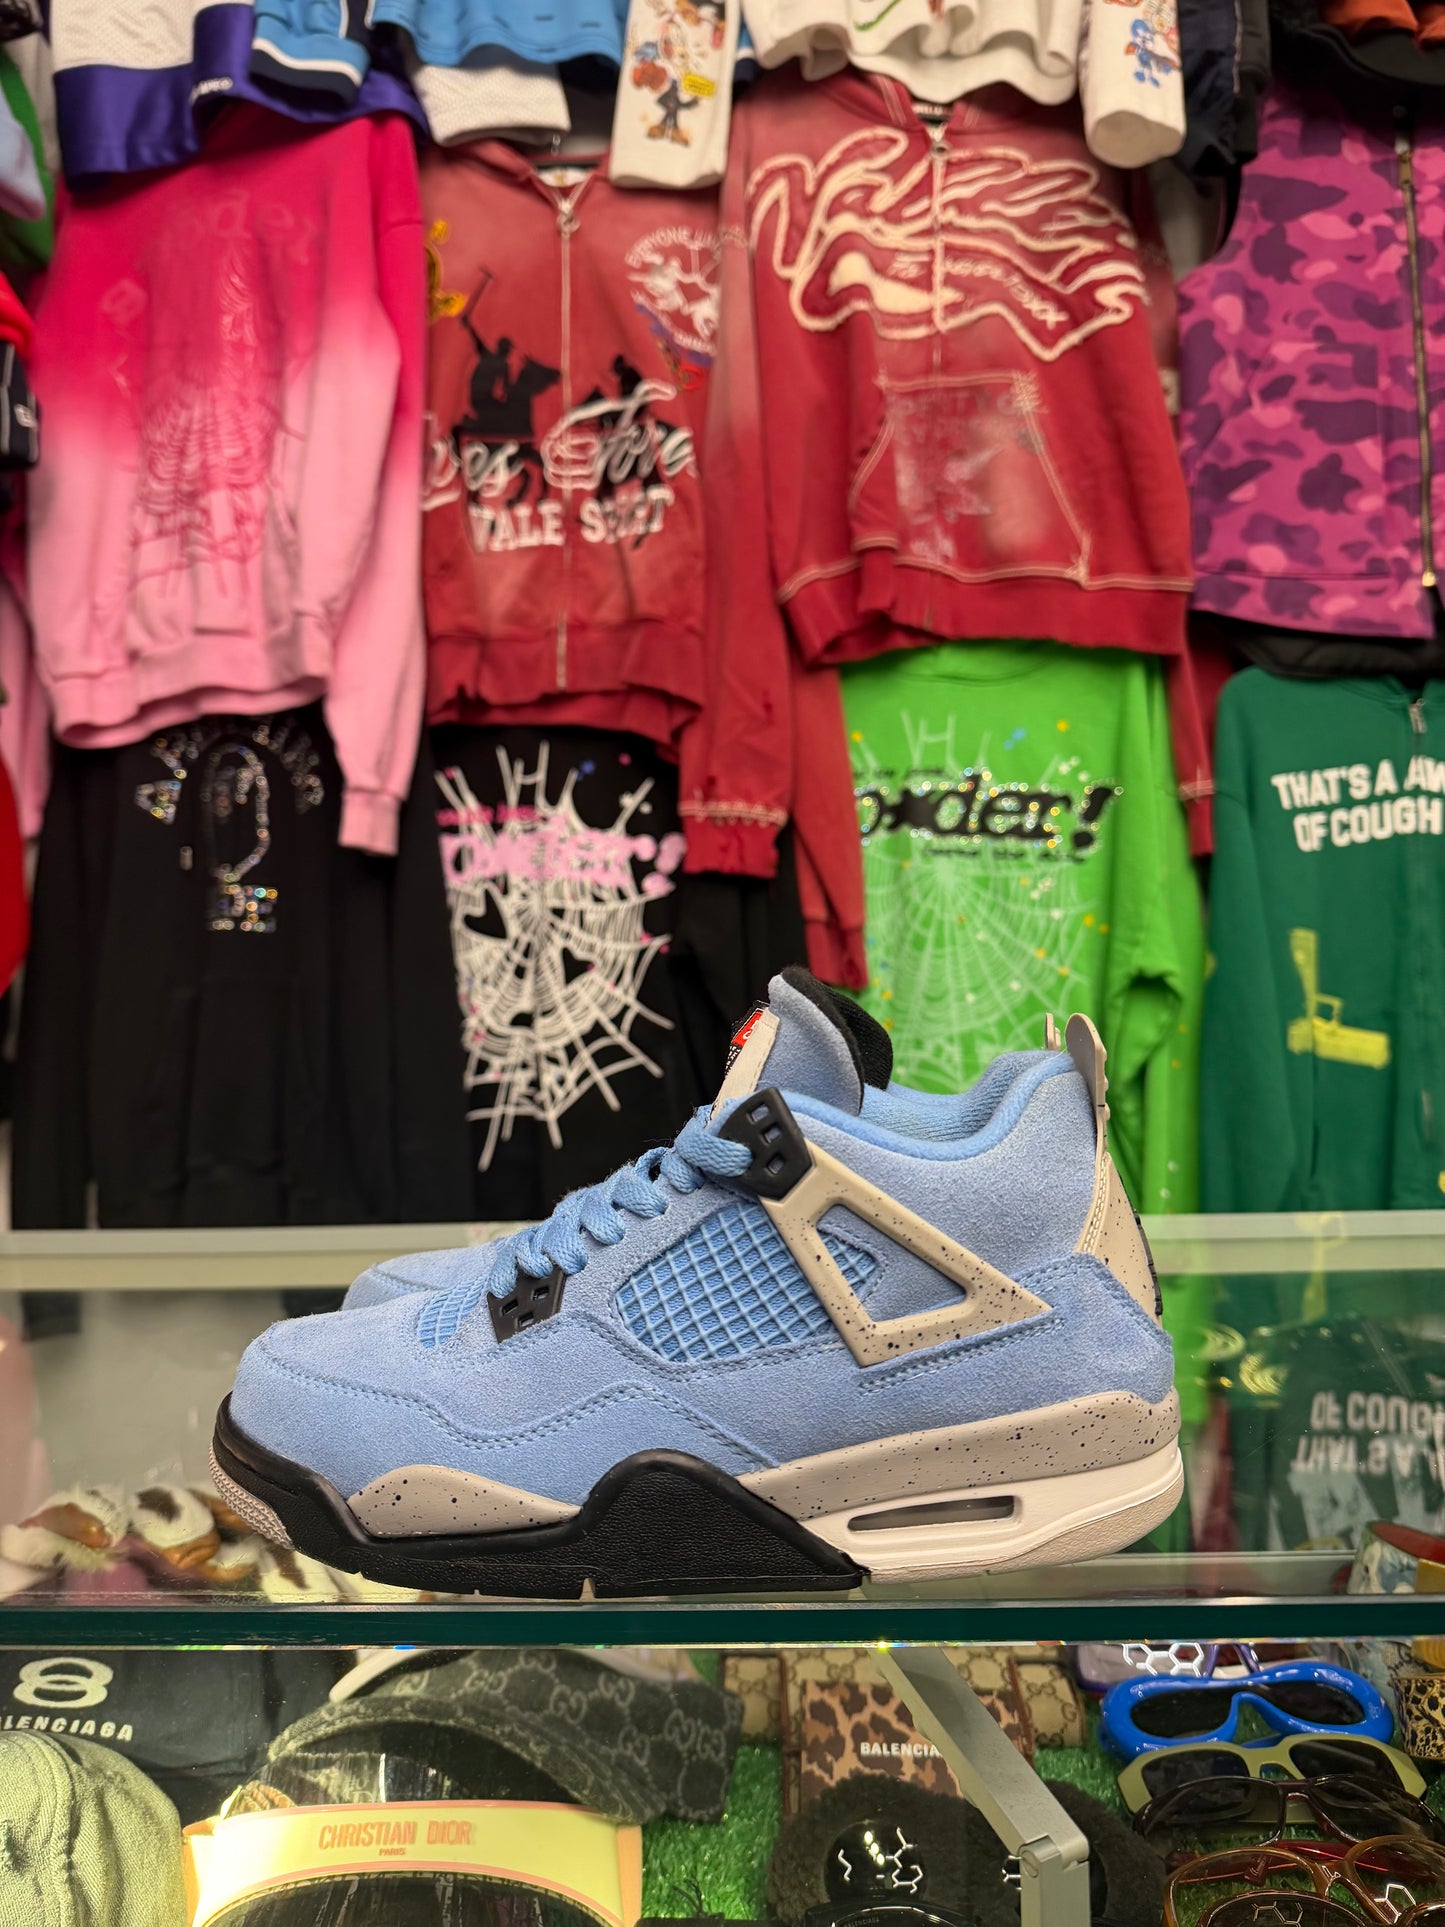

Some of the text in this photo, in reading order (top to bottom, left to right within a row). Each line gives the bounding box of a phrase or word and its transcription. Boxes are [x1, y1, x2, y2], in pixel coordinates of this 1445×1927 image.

[468, 500, 566, 552] VALE
[1270, 764, 1372, 810] THAT'S
[1374, 758, 1399, 797] A
[1293, 796, 1442, 853] OF COUGH
[0, 1715, 133, 1742] LENCIAGA
[319, 1819, 474, 1851] CHRISTIAN DIOR
[379, 1847, 407, 1856] PARIS
